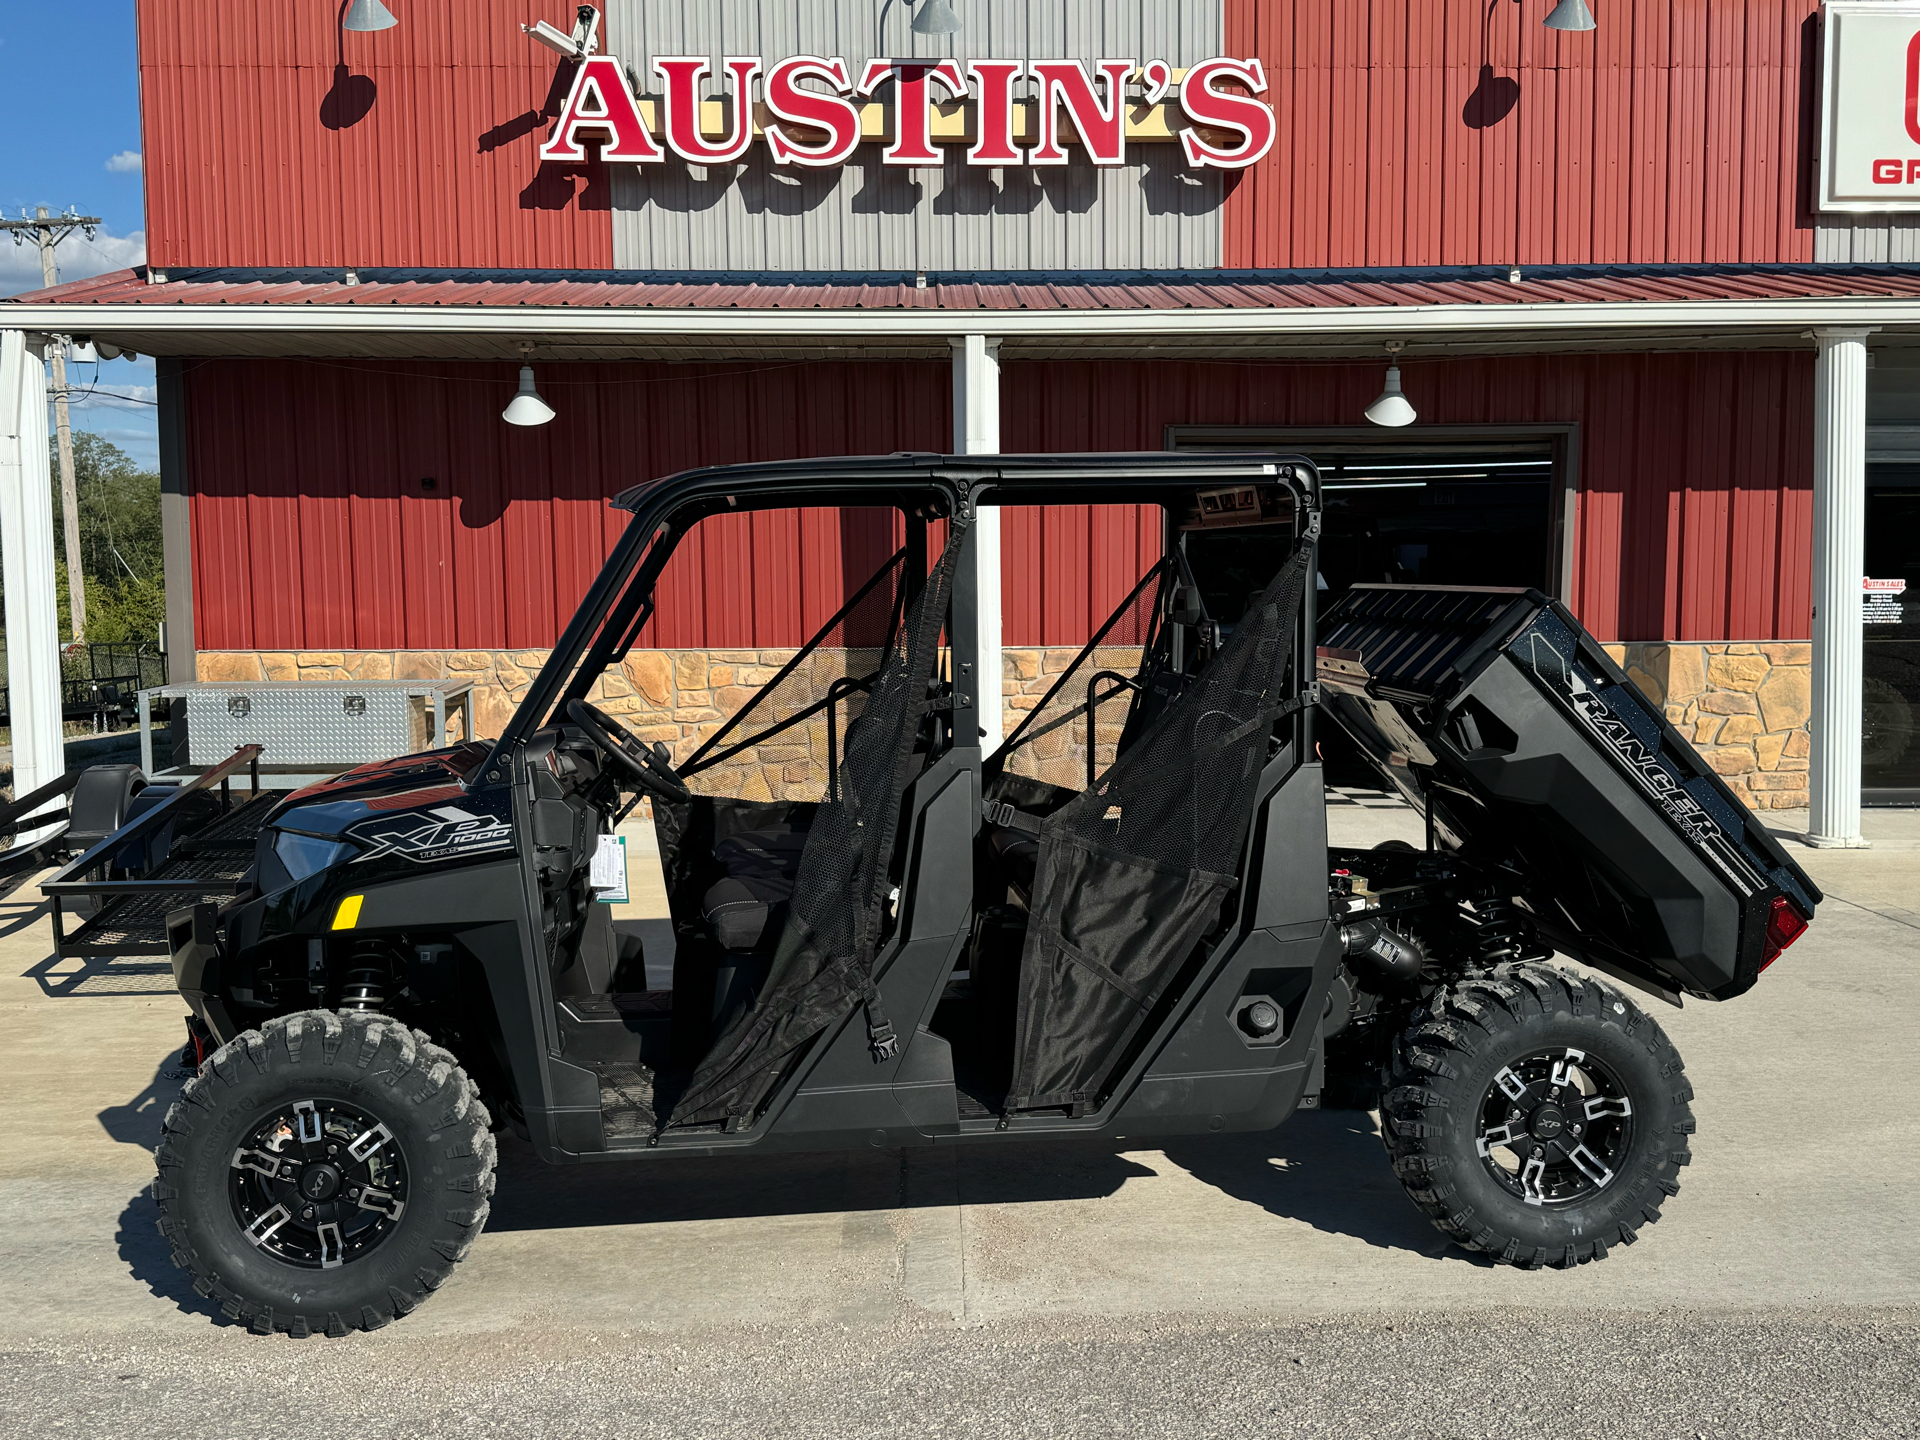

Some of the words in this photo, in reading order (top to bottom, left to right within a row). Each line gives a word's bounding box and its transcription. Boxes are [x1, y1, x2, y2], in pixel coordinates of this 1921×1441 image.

[540, 55, 1277, 169] AUSTIN'S
[1571, 690, 1721, 839] RANGER
[351, 814, 502, 864] XP
[453, 829, 511, 844] 1000
[1662, 800, 1705, 845] TEXAS
[419, 846, 459, 859] TEXAS
[1537, 1118, 1562, 1129] XP
[311, 1172, 324, 1197] XP
